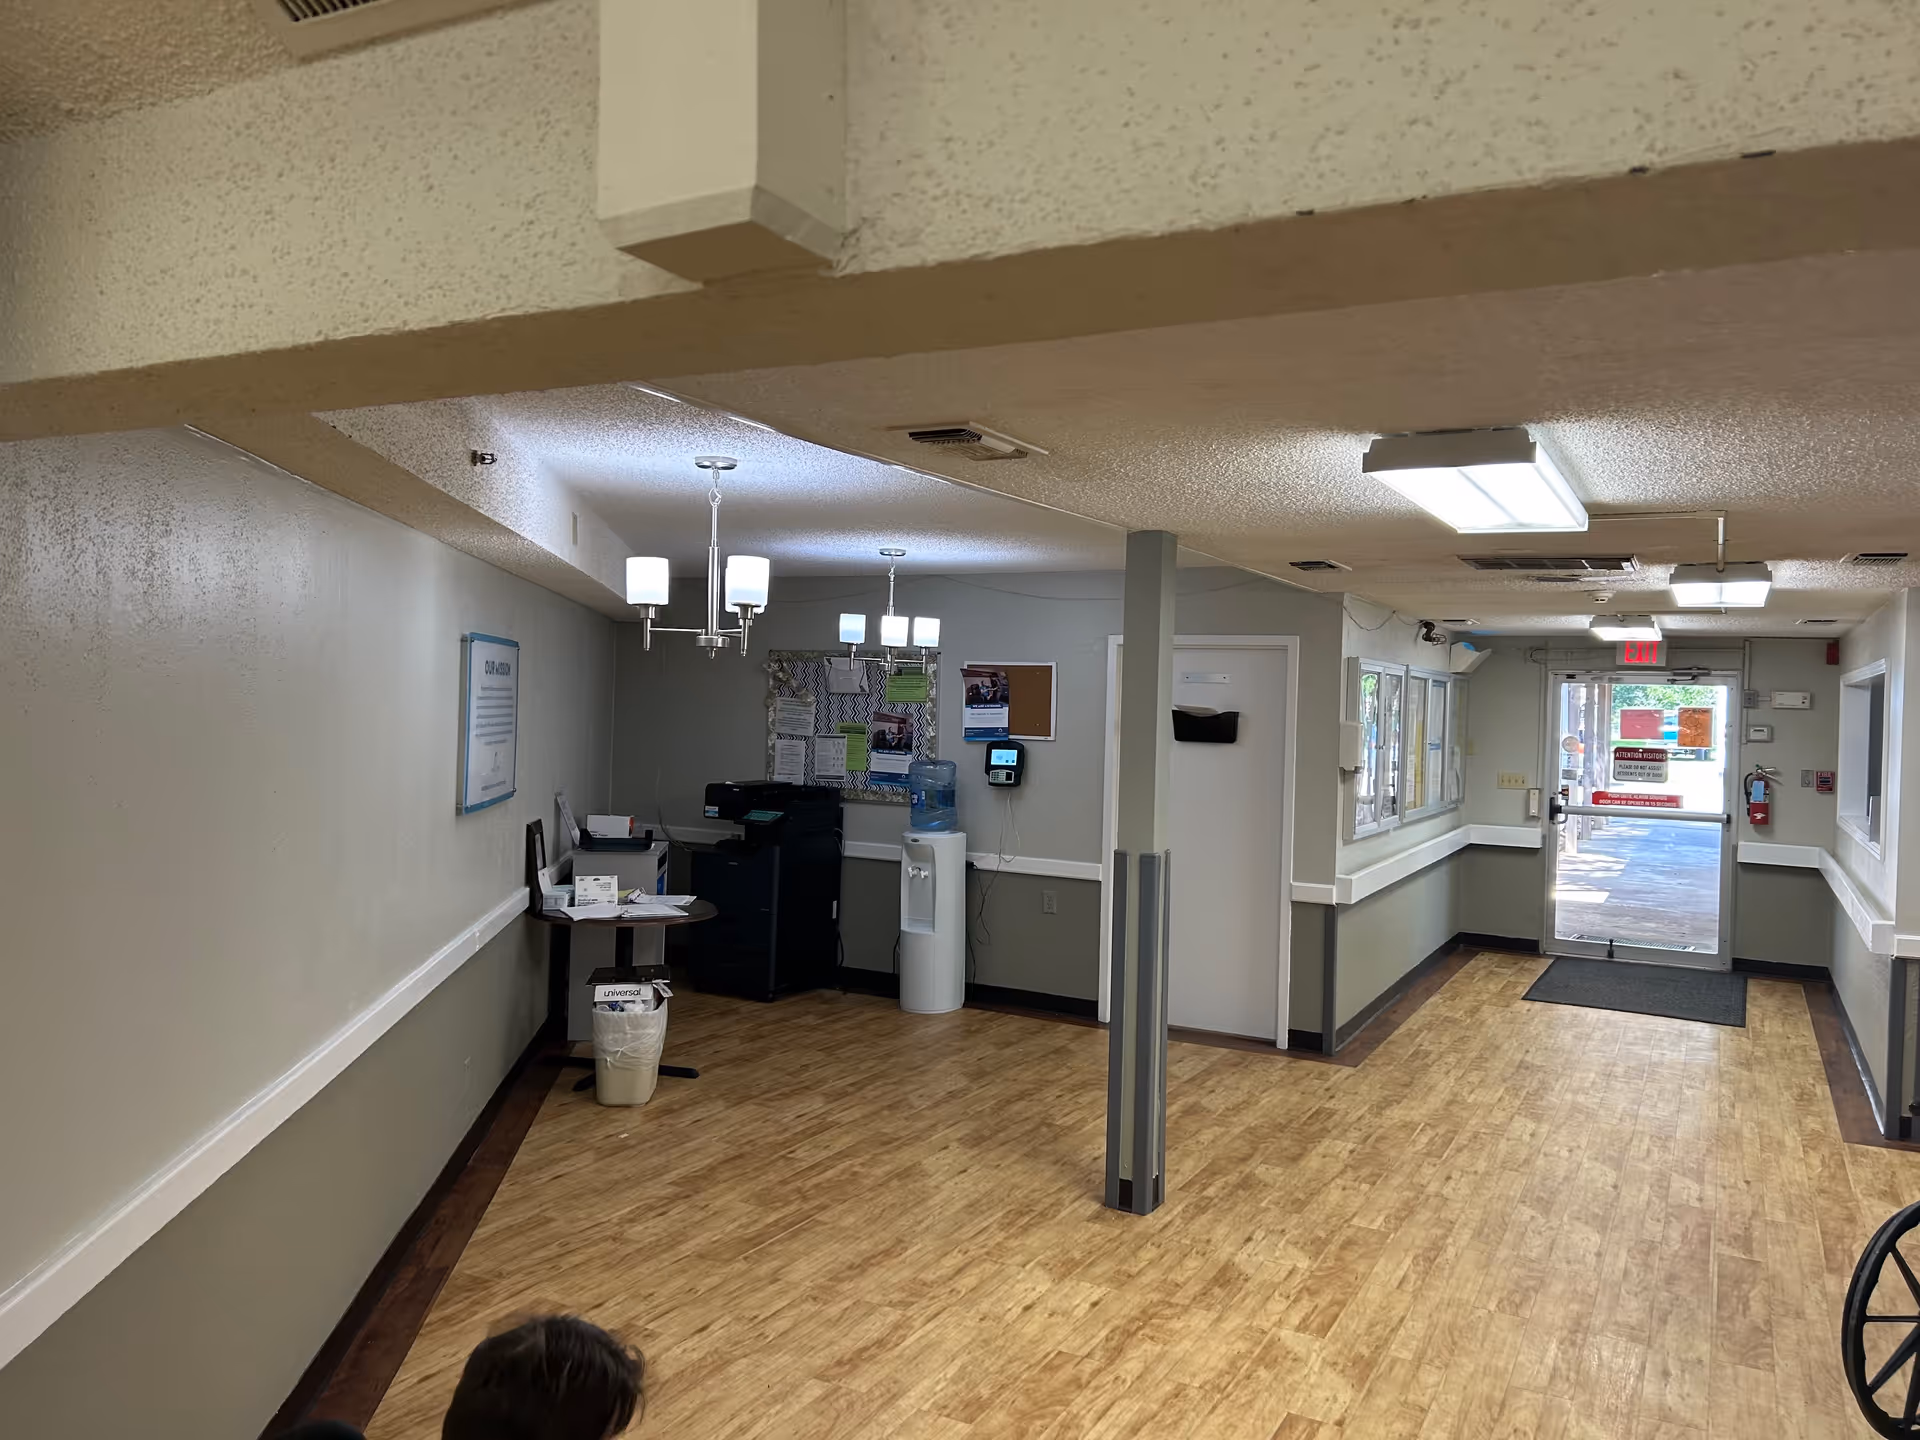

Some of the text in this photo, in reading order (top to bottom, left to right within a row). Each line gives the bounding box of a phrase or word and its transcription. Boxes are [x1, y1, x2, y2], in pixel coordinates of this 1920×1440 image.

[1625, 640, 1658, 664] EXIT
[485, 660, 494, 675] OUR
[1616, 751, 1666, 760] ATTENTION VISITORS
[603, 987, 641, 997] universal
